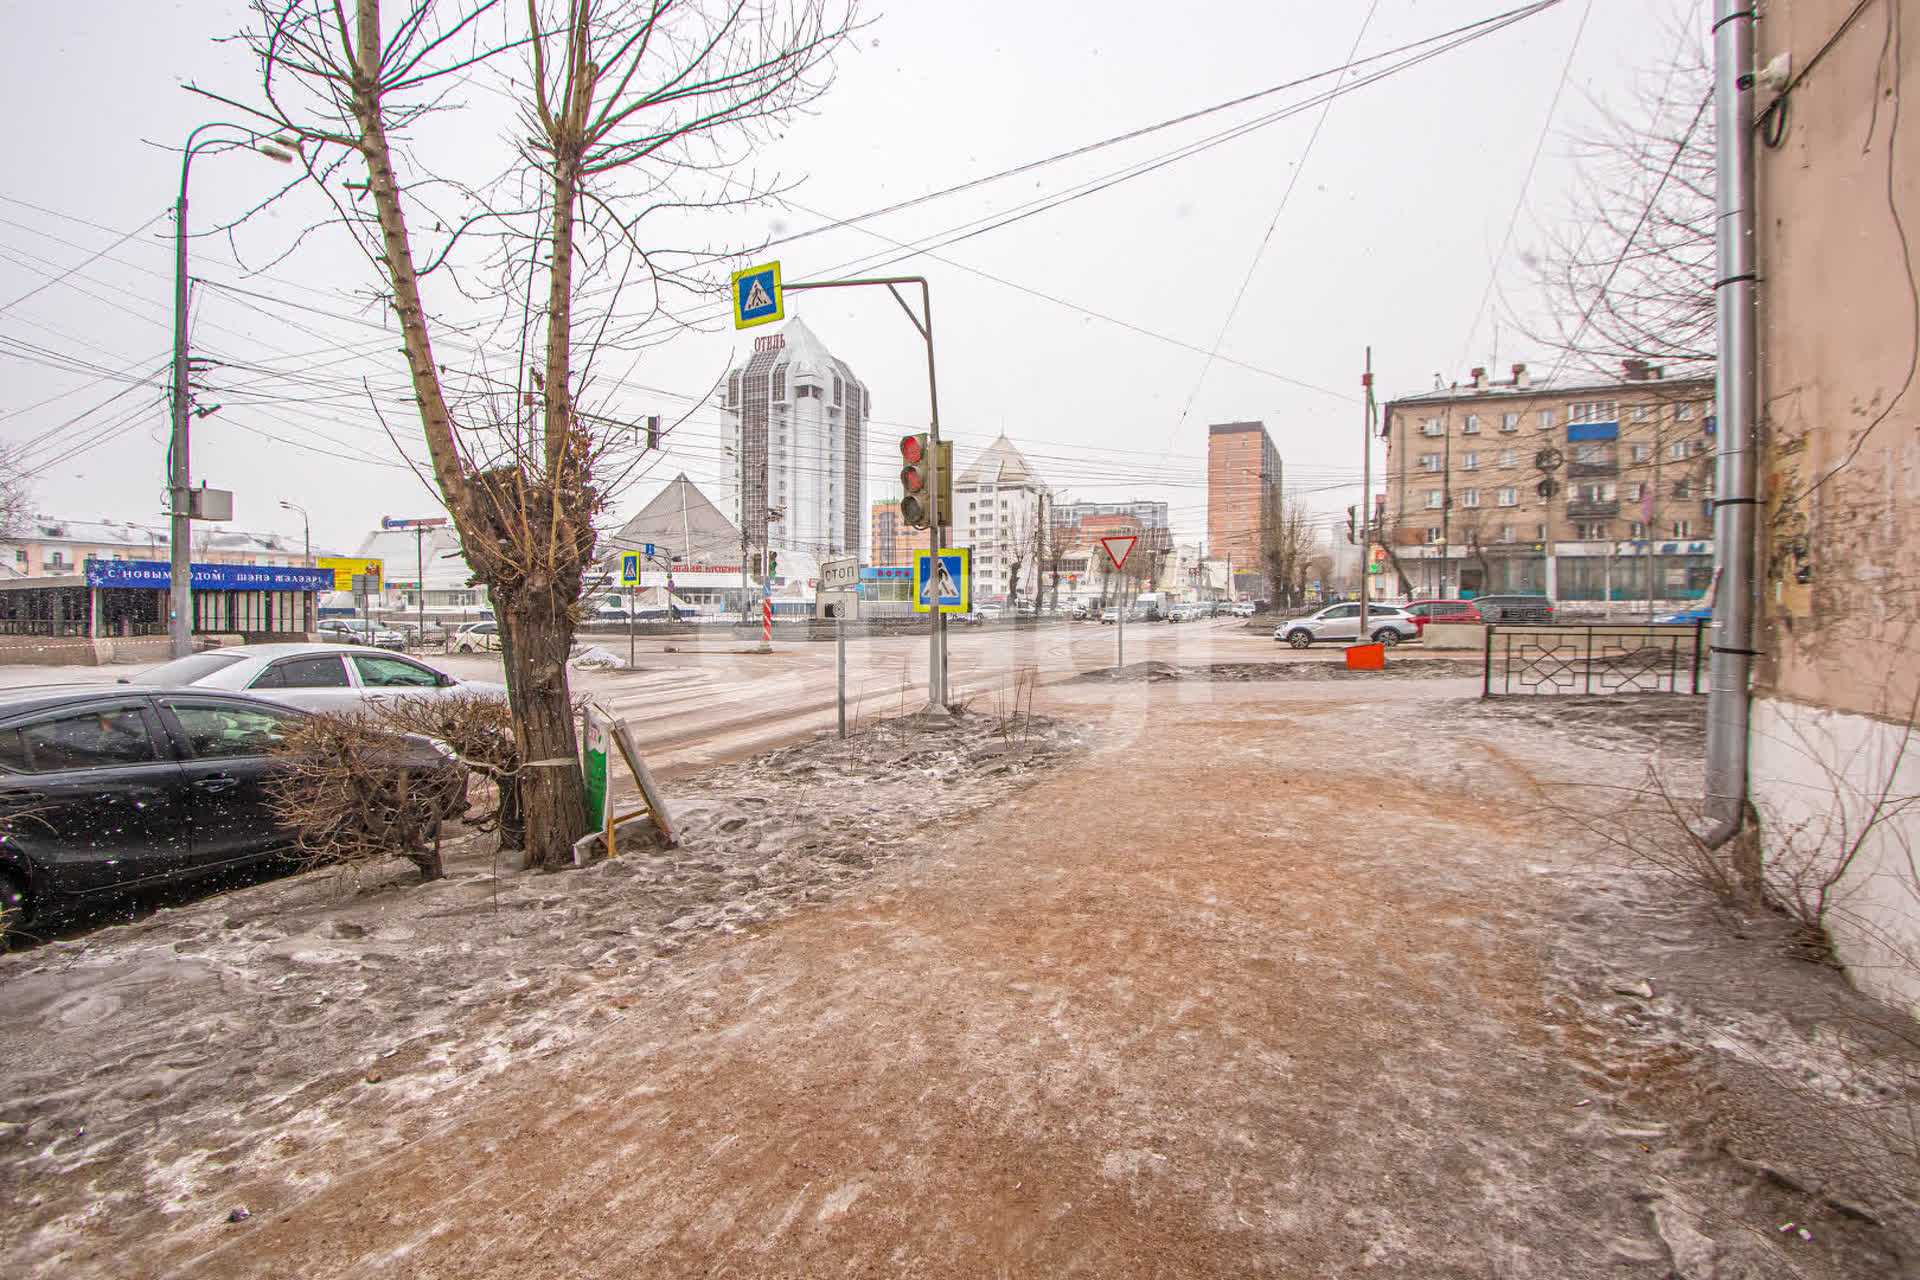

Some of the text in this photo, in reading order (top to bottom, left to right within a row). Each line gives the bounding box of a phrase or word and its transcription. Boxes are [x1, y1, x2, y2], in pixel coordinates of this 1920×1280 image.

[755, 333, 786, 352] ОТЕЛЬ
[123, 571, 172, 580] НОВЫМ
[825, 566, 854, 581] СТОП
